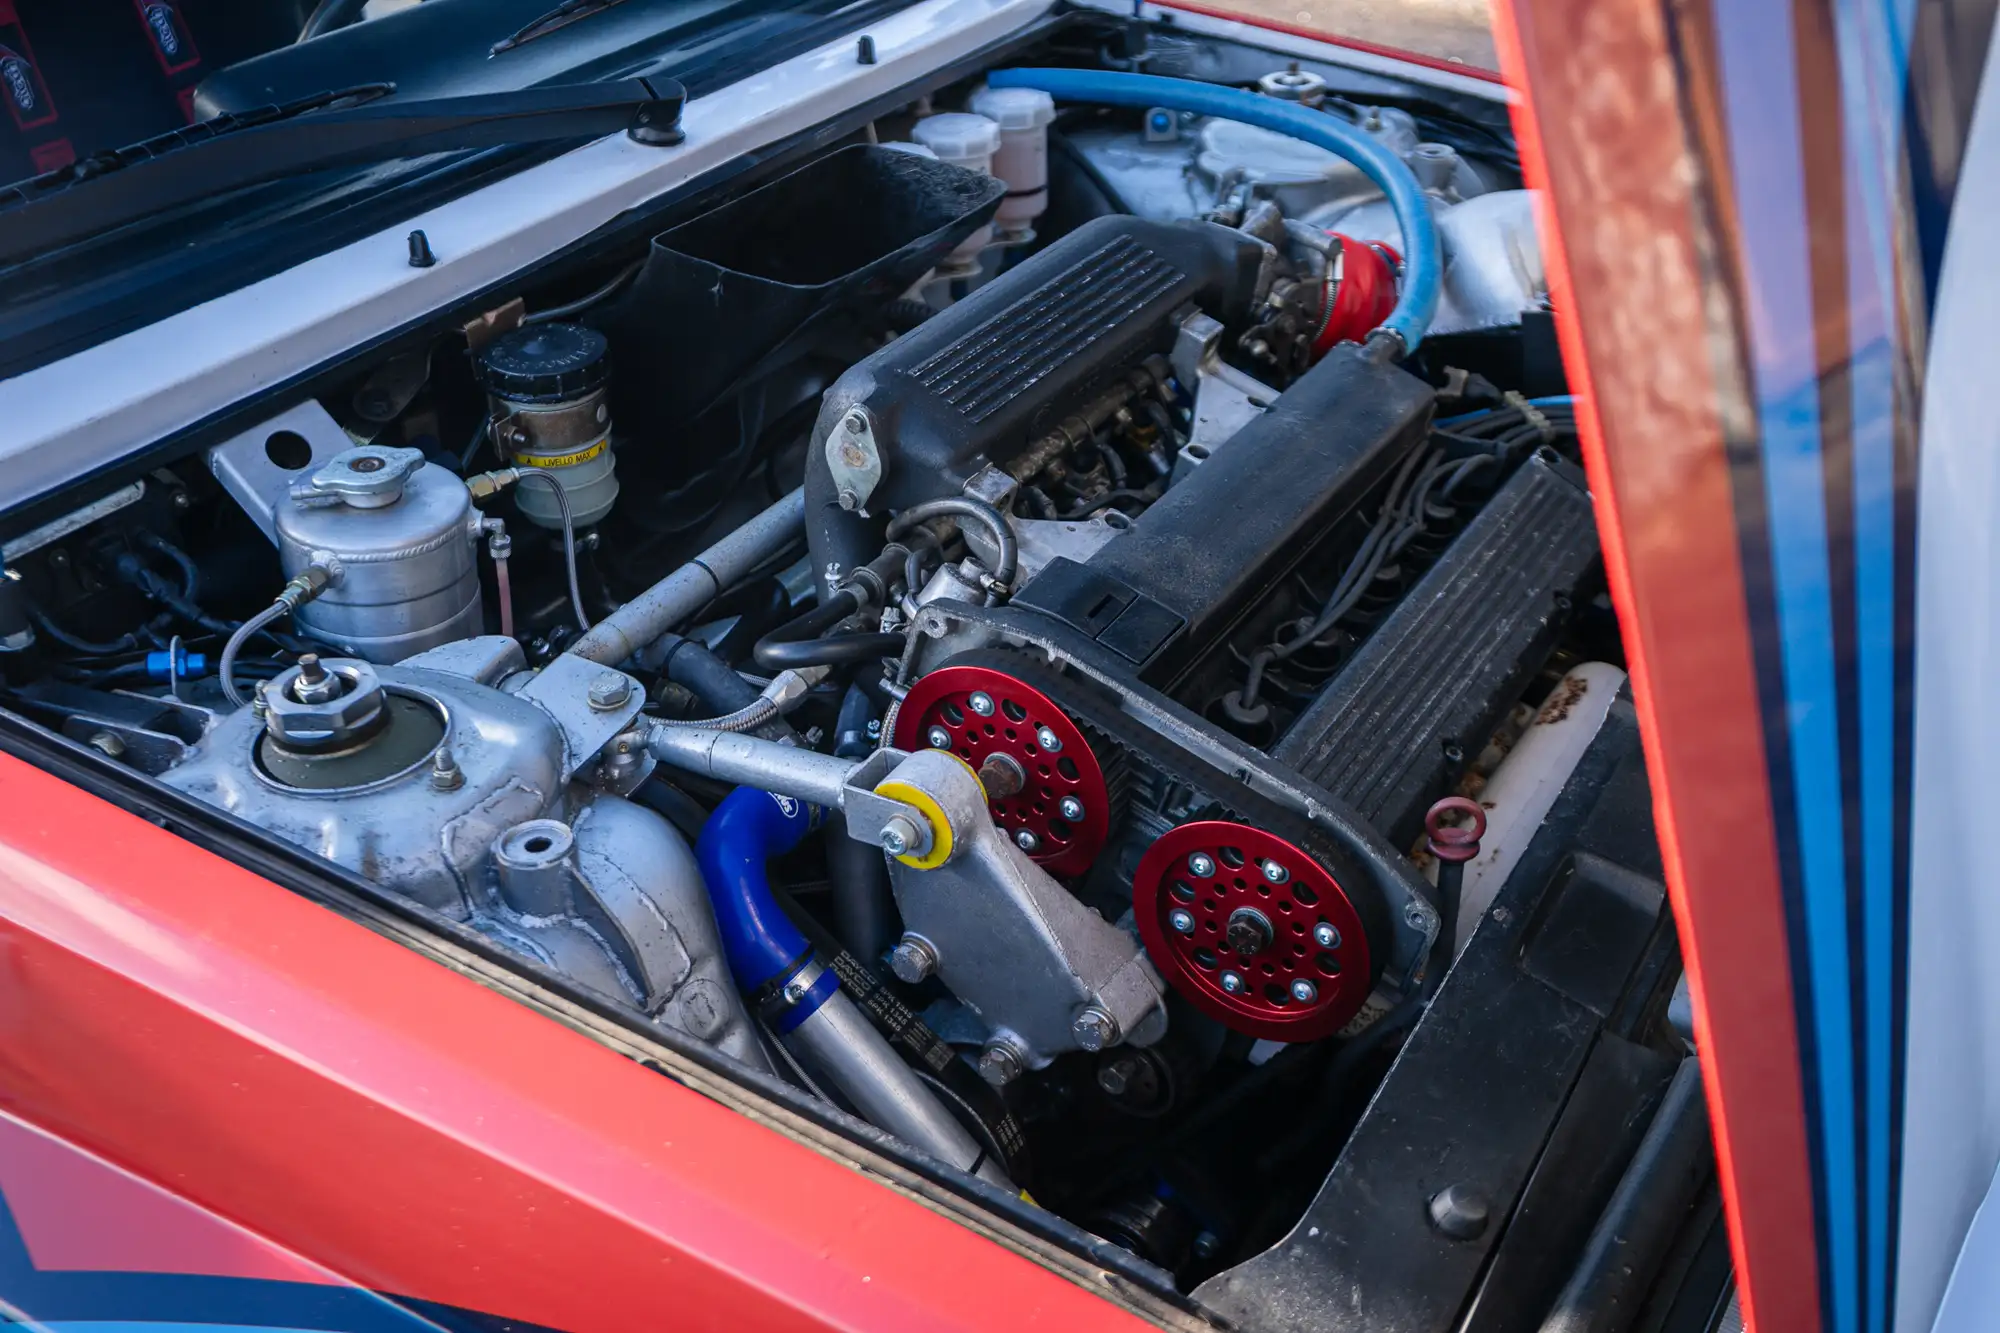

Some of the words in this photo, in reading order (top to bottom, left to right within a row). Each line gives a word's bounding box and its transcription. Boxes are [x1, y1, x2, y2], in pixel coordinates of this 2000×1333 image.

[544, 456, 573, 467] LIVELLO
[575, 451, 592, 462] MAX
[834, 956, 871, 991] DAYCO
[840, 950, 878, 985] DAYCO
